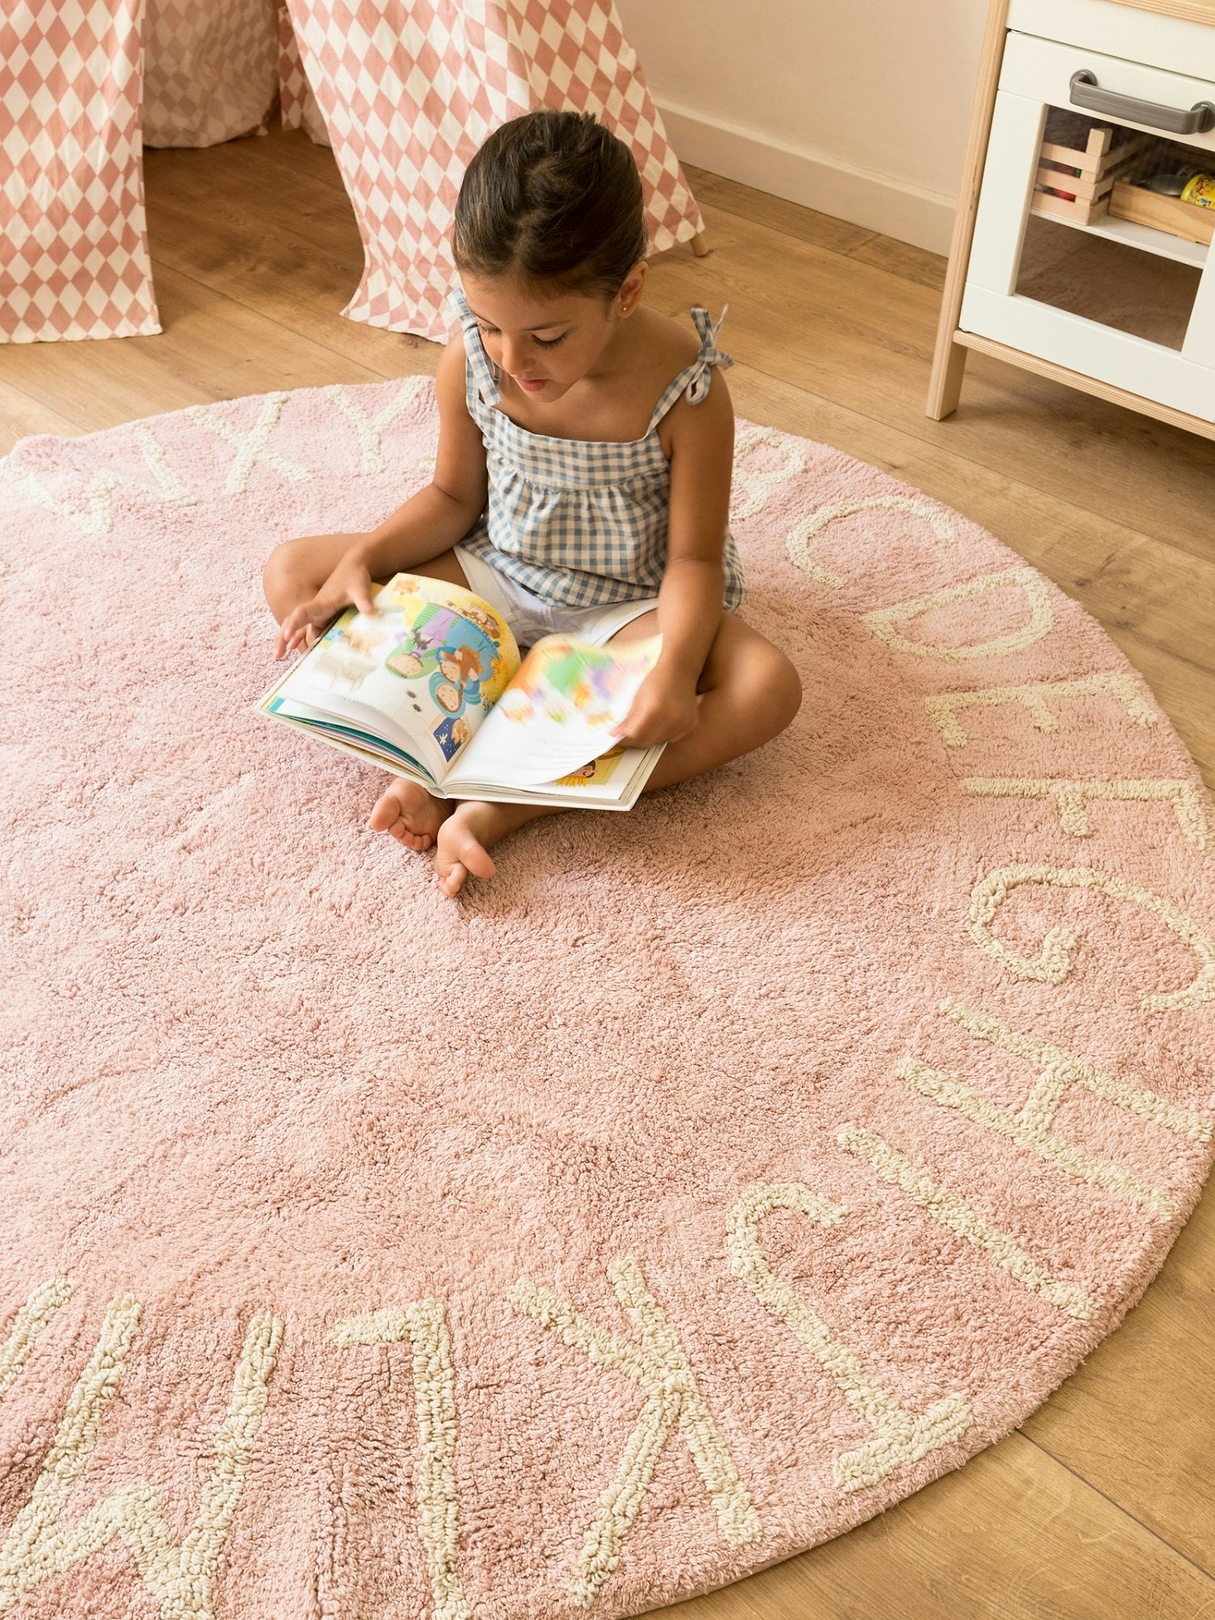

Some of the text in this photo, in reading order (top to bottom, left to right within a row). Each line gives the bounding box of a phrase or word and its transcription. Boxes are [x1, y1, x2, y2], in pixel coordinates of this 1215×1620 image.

[0, 375, 431, 534] W X Y
[786, 496, 956, 590] C
[861, 567, 1055, 661] D
[924, 672, 1158, 749] E
[961, 776, 1207, 848] F
[964, 862, 1215, 1011] G
[897, 1000, 1214, 1222] H
[836, 1123, 1100, 1323] I
[725, 1183, 974, 1492] J
[0, 1294, 284, 1620] M
[329, 1300, 471, 1620] L
[506, 1256, 763, 1605] K
